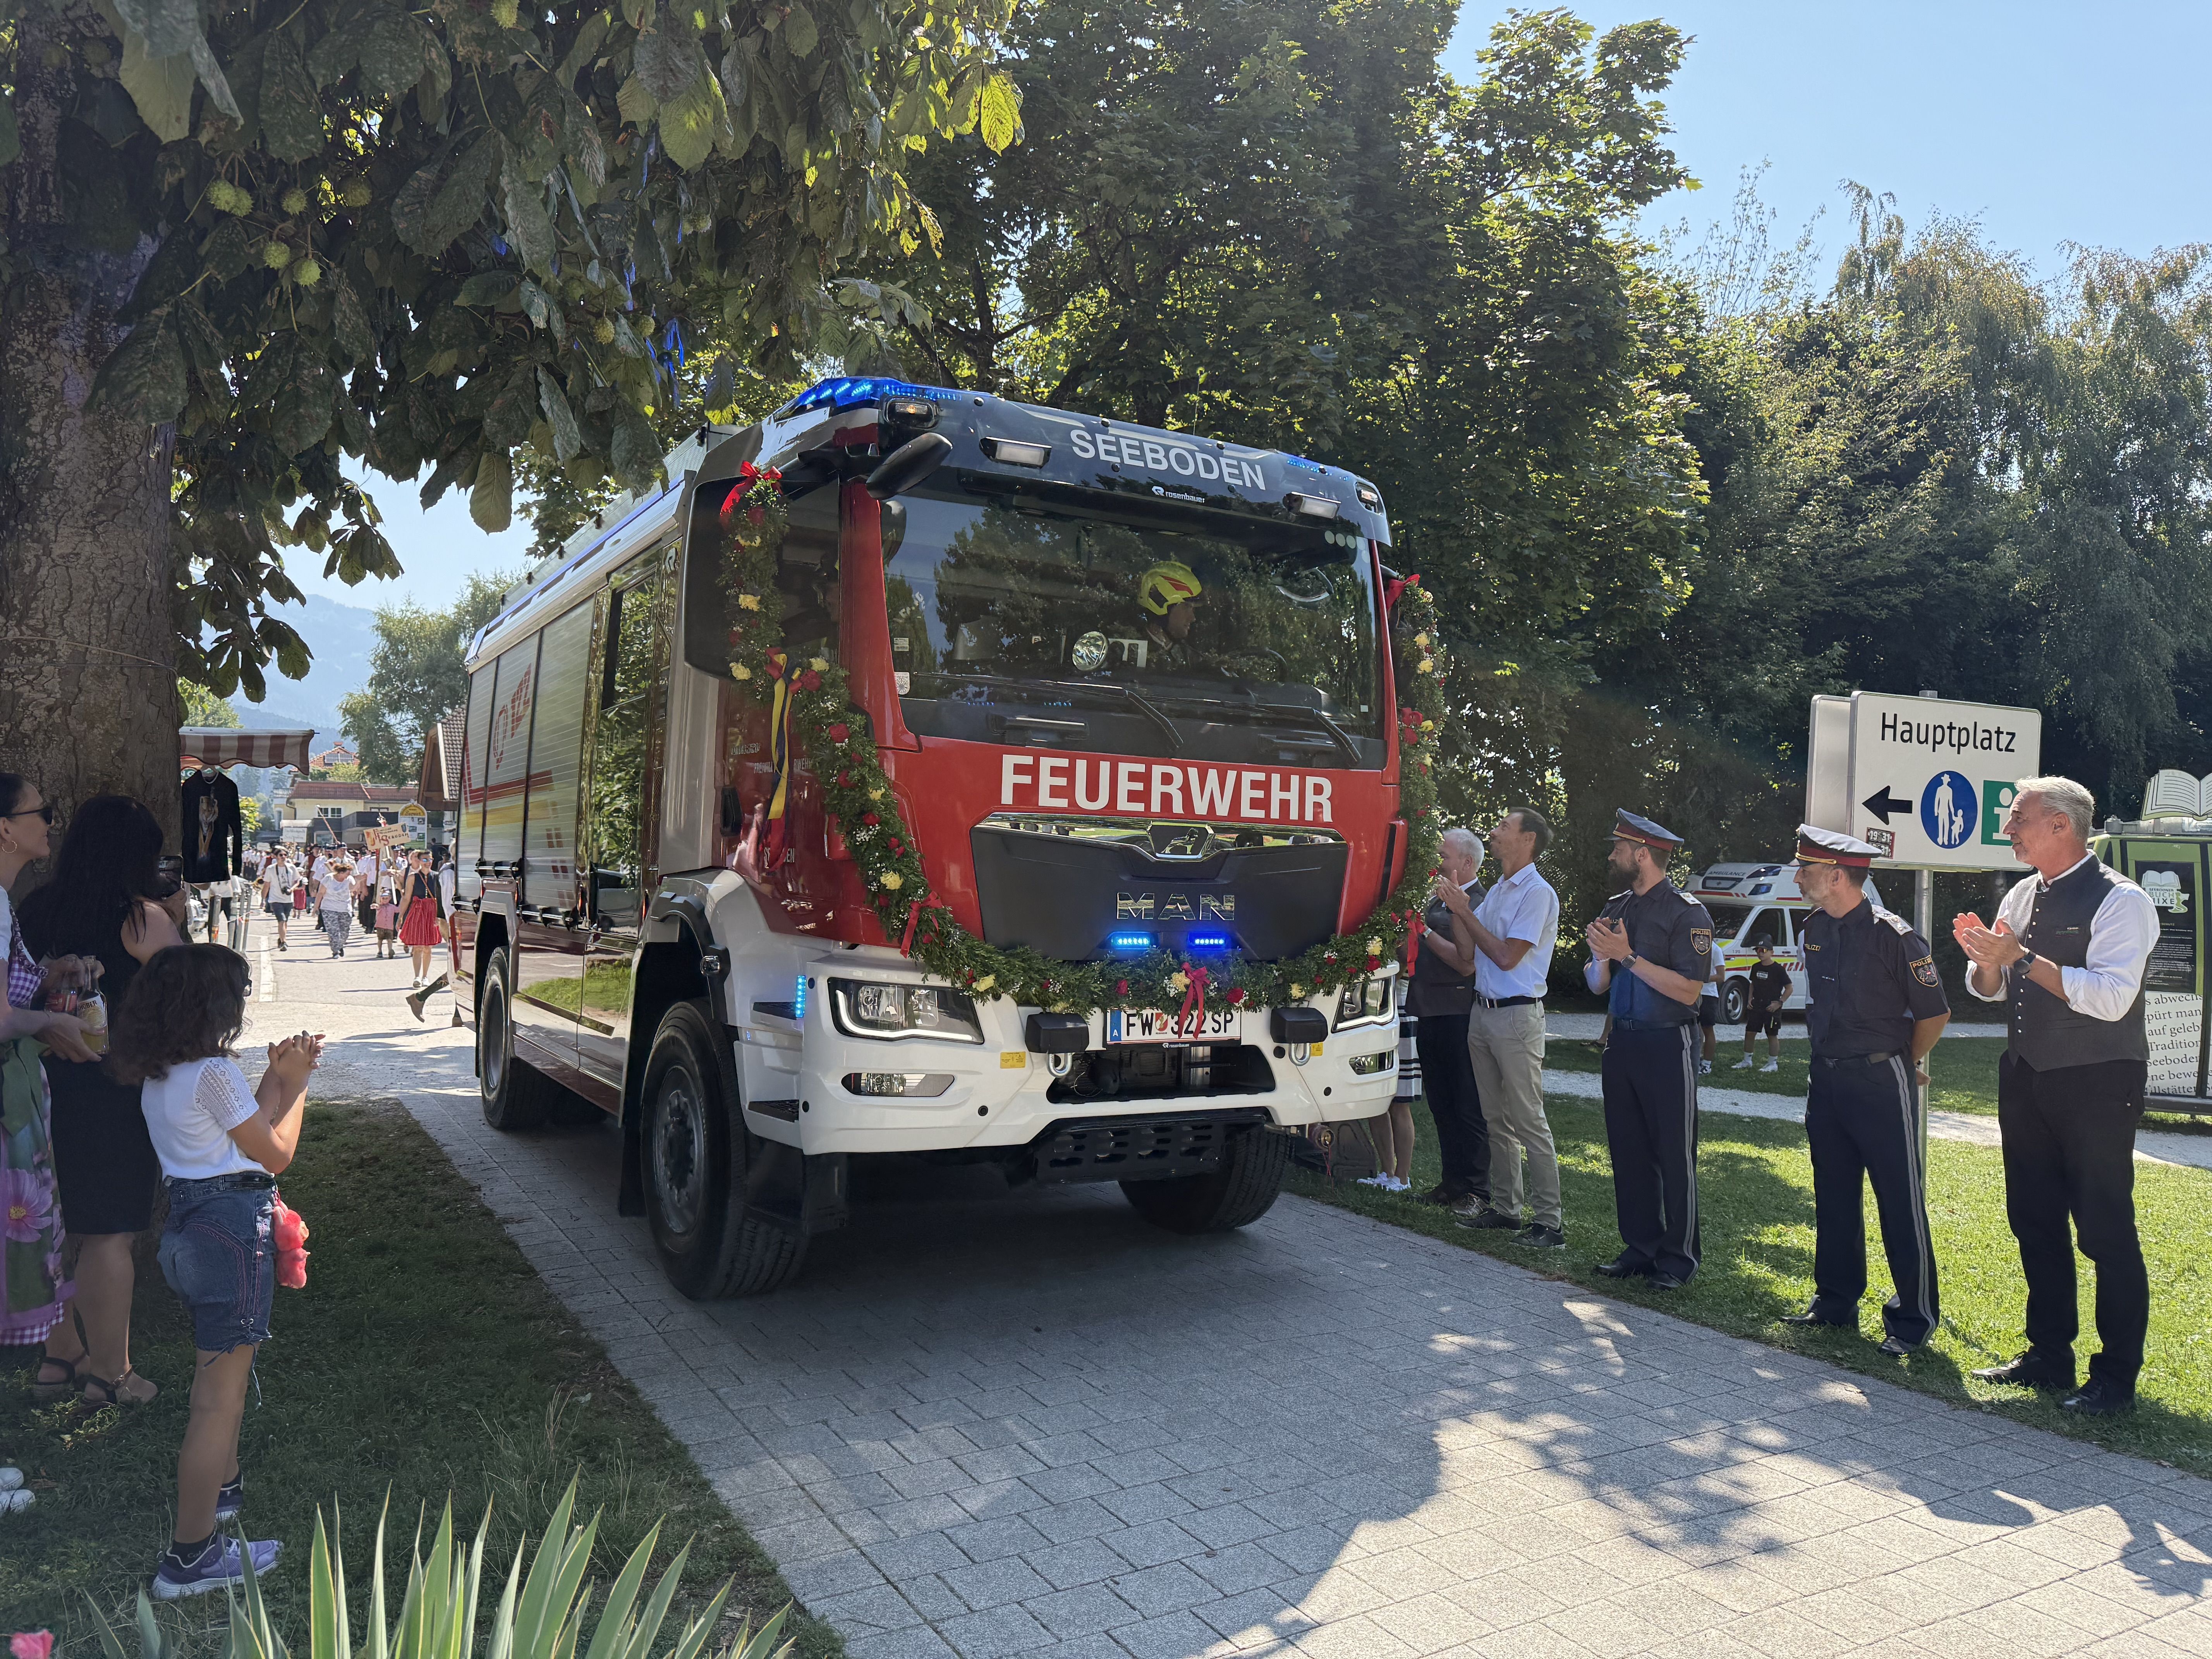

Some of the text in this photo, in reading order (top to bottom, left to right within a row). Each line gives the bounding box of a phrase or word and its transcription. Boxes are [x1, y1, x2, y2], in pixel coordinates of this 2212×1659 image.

[1070, 429, 1266, 490] SEEBODEN
[1165, 491, 1205, 503] rosenbauer
[1881, 712, 2016, 755] Hauptplatz
[1001, 754, 1333, 823] FEUERWEHR
[1116, 892, 1235, 921] MAN
[1113, 1029, 1119, 1037] A
[1126, 1012, 1154, 1037] FW
[1211, 1012, 1234, 1034] SP
[2144, 1010, 2172, 1024] pürt
[2148, 1022, 2202, 1037] auf geleb
